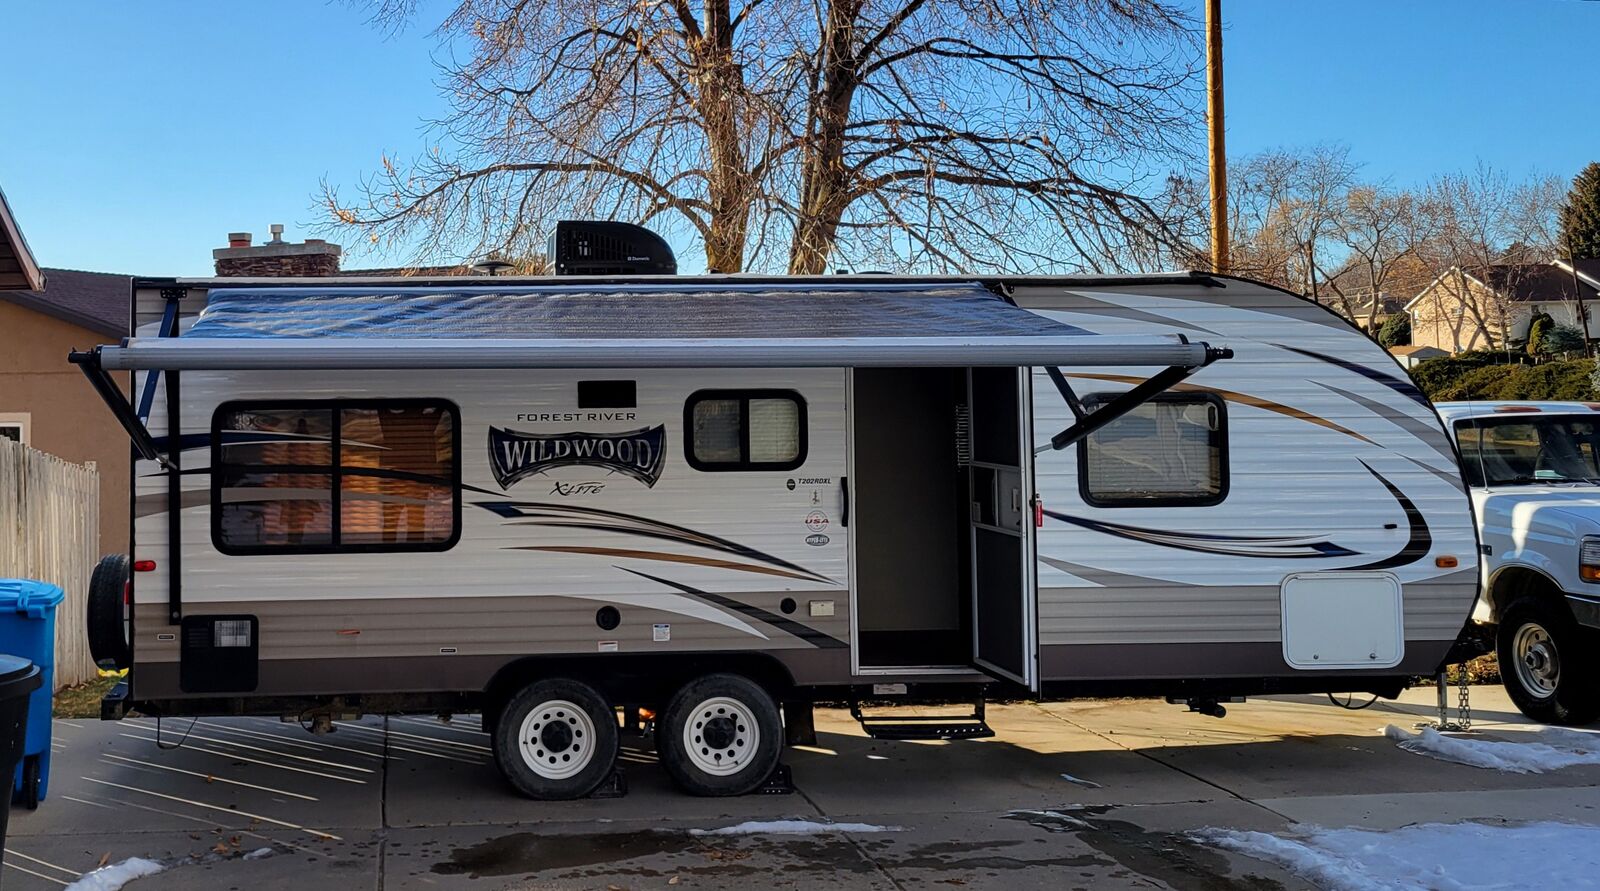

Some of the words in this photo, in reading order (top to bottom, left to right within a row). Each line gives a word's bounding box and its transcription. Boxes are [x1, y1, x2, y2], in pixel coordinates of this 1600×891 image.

[517, 413, 583, 422] FOREST
[588, 412, 636, 421] RIVER
[502, 439, 651, 471] WILDWOOD
